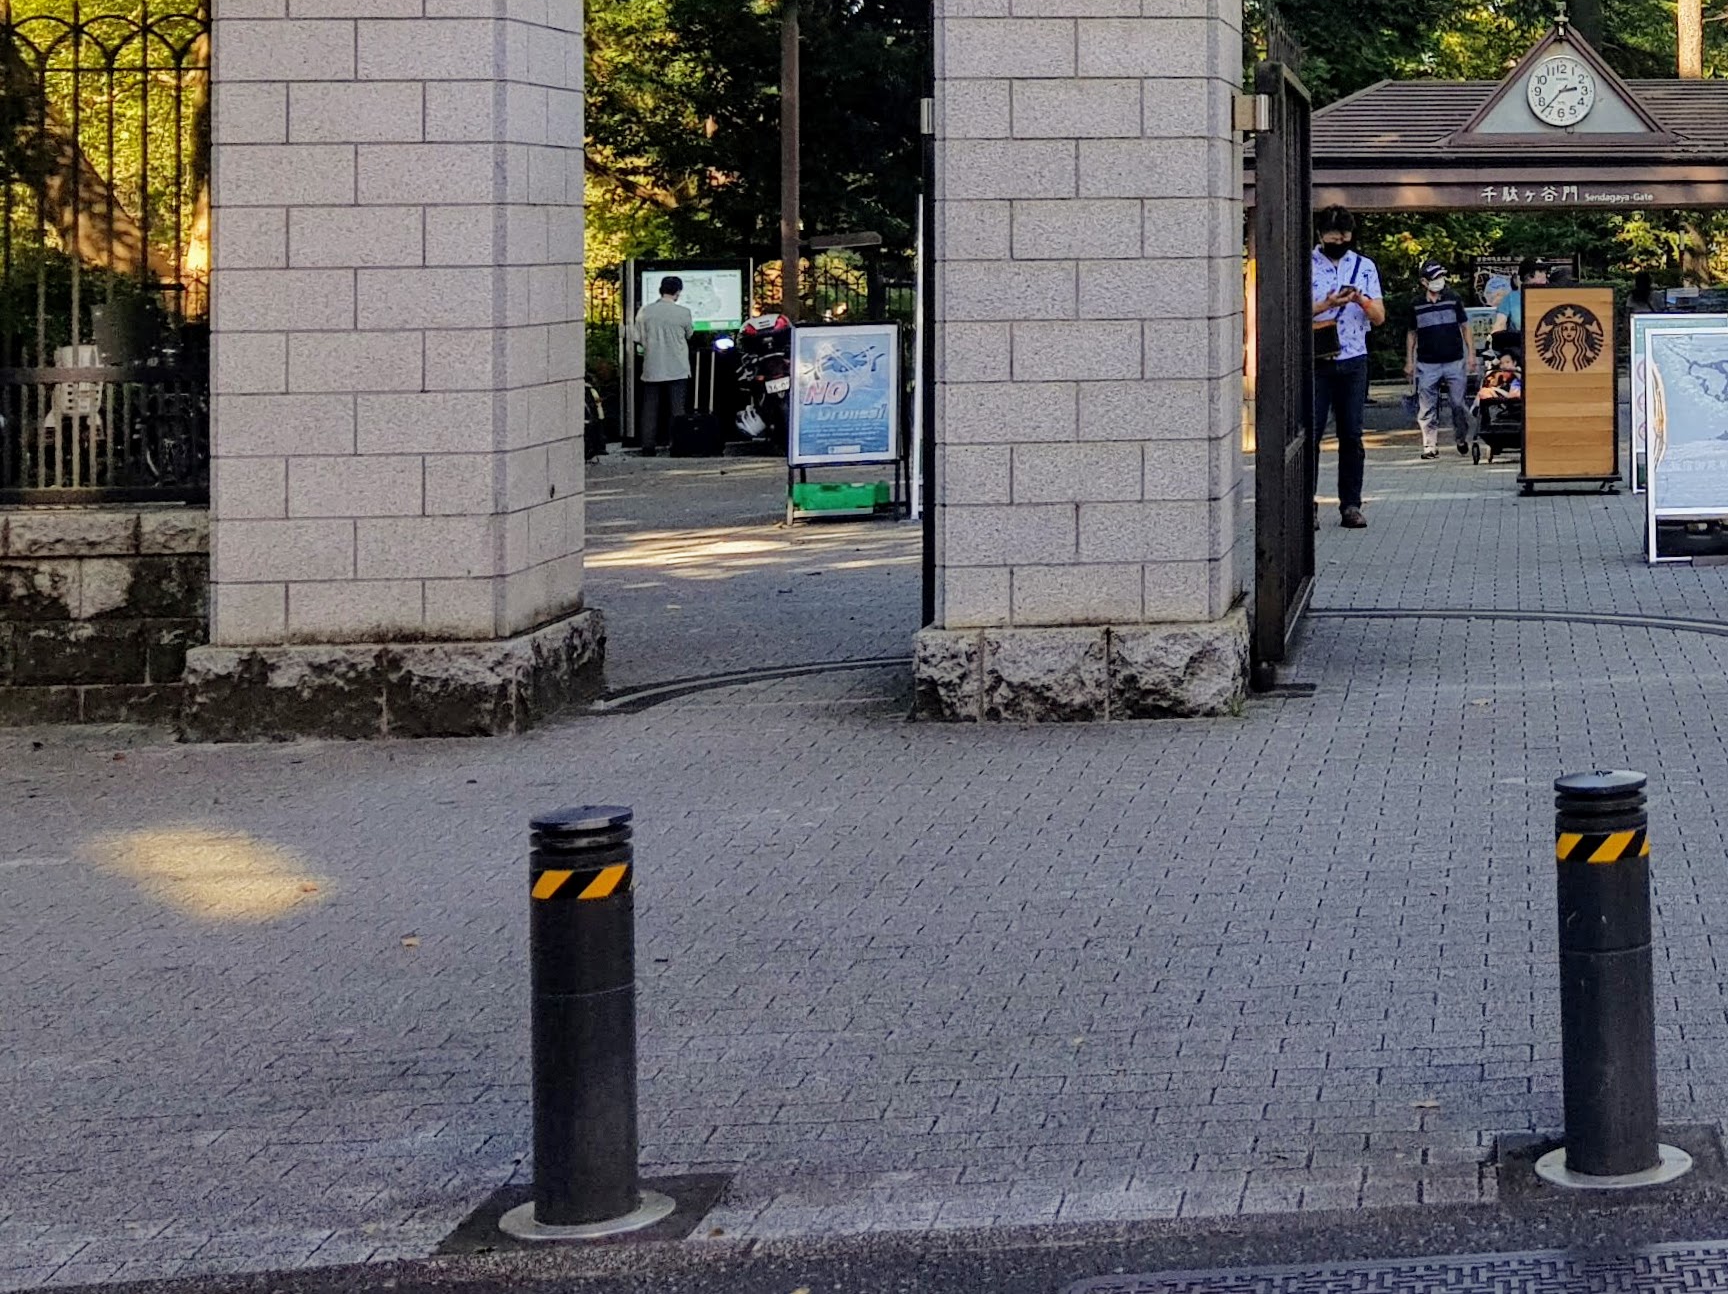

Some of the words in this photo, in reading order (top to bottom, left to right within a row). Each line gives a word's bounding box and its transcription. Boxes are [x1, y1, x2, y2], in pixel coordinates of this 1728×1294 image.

[1546, 65, 1555, 76] 11
[1557, 64, 1567, 74] 12
[1535, 75, 1547, 85] 10
[1578, 74, 1585, 84] 2
[1534, 86, 1542, 96] 9
[1581, 86, 1588, 96] 3
[1538, 97, 1546, 107] 8
[1577, 97, 1585, 106] 4
[1547, 105, 1554, 115] 7
[1557, 108, 1565, 118] 6
[1569, 105, 1577, 115] 5
[803, 381, 850, 405] NO
